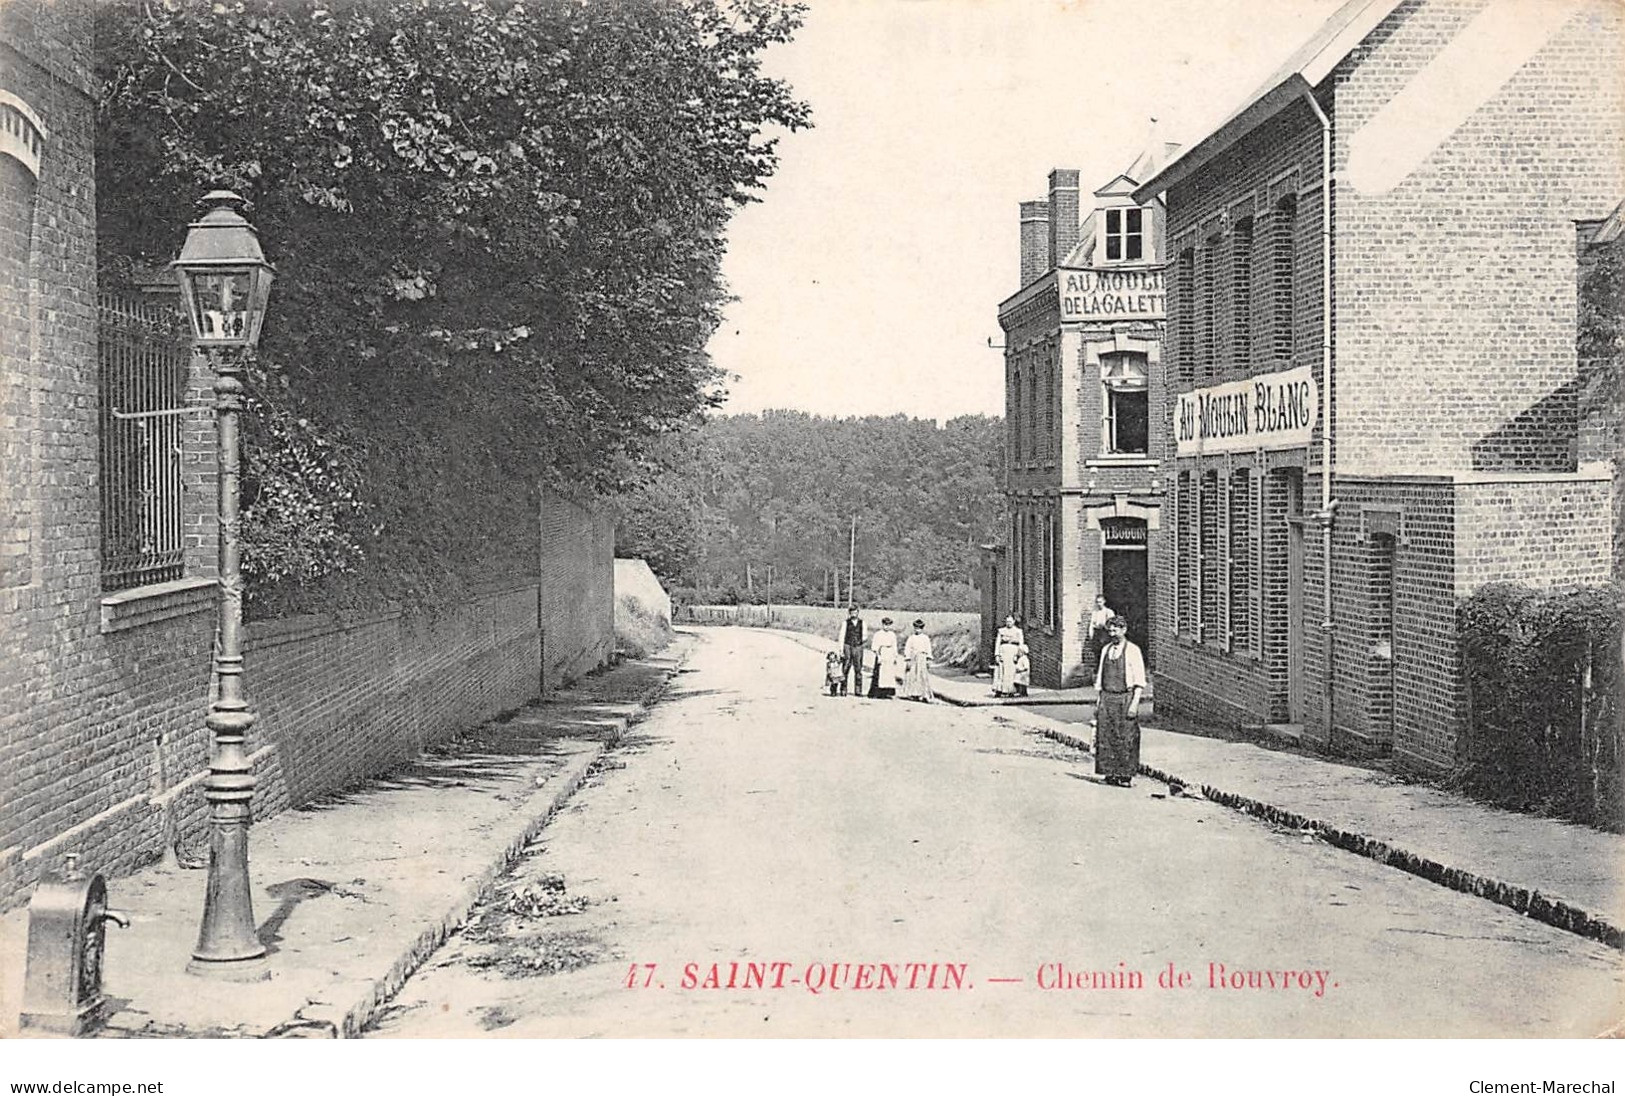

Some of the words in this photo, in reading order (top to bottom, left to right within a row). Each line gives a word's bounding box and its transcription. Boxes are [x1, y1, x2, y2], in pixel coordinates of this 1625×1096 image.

[1066, 274, 1090, 292] AU
[1179, 397, 1195, 441] AU
[1198, 391, 1249, 438] MOULIN
[1254, 380, 1310, 433] BLANC
